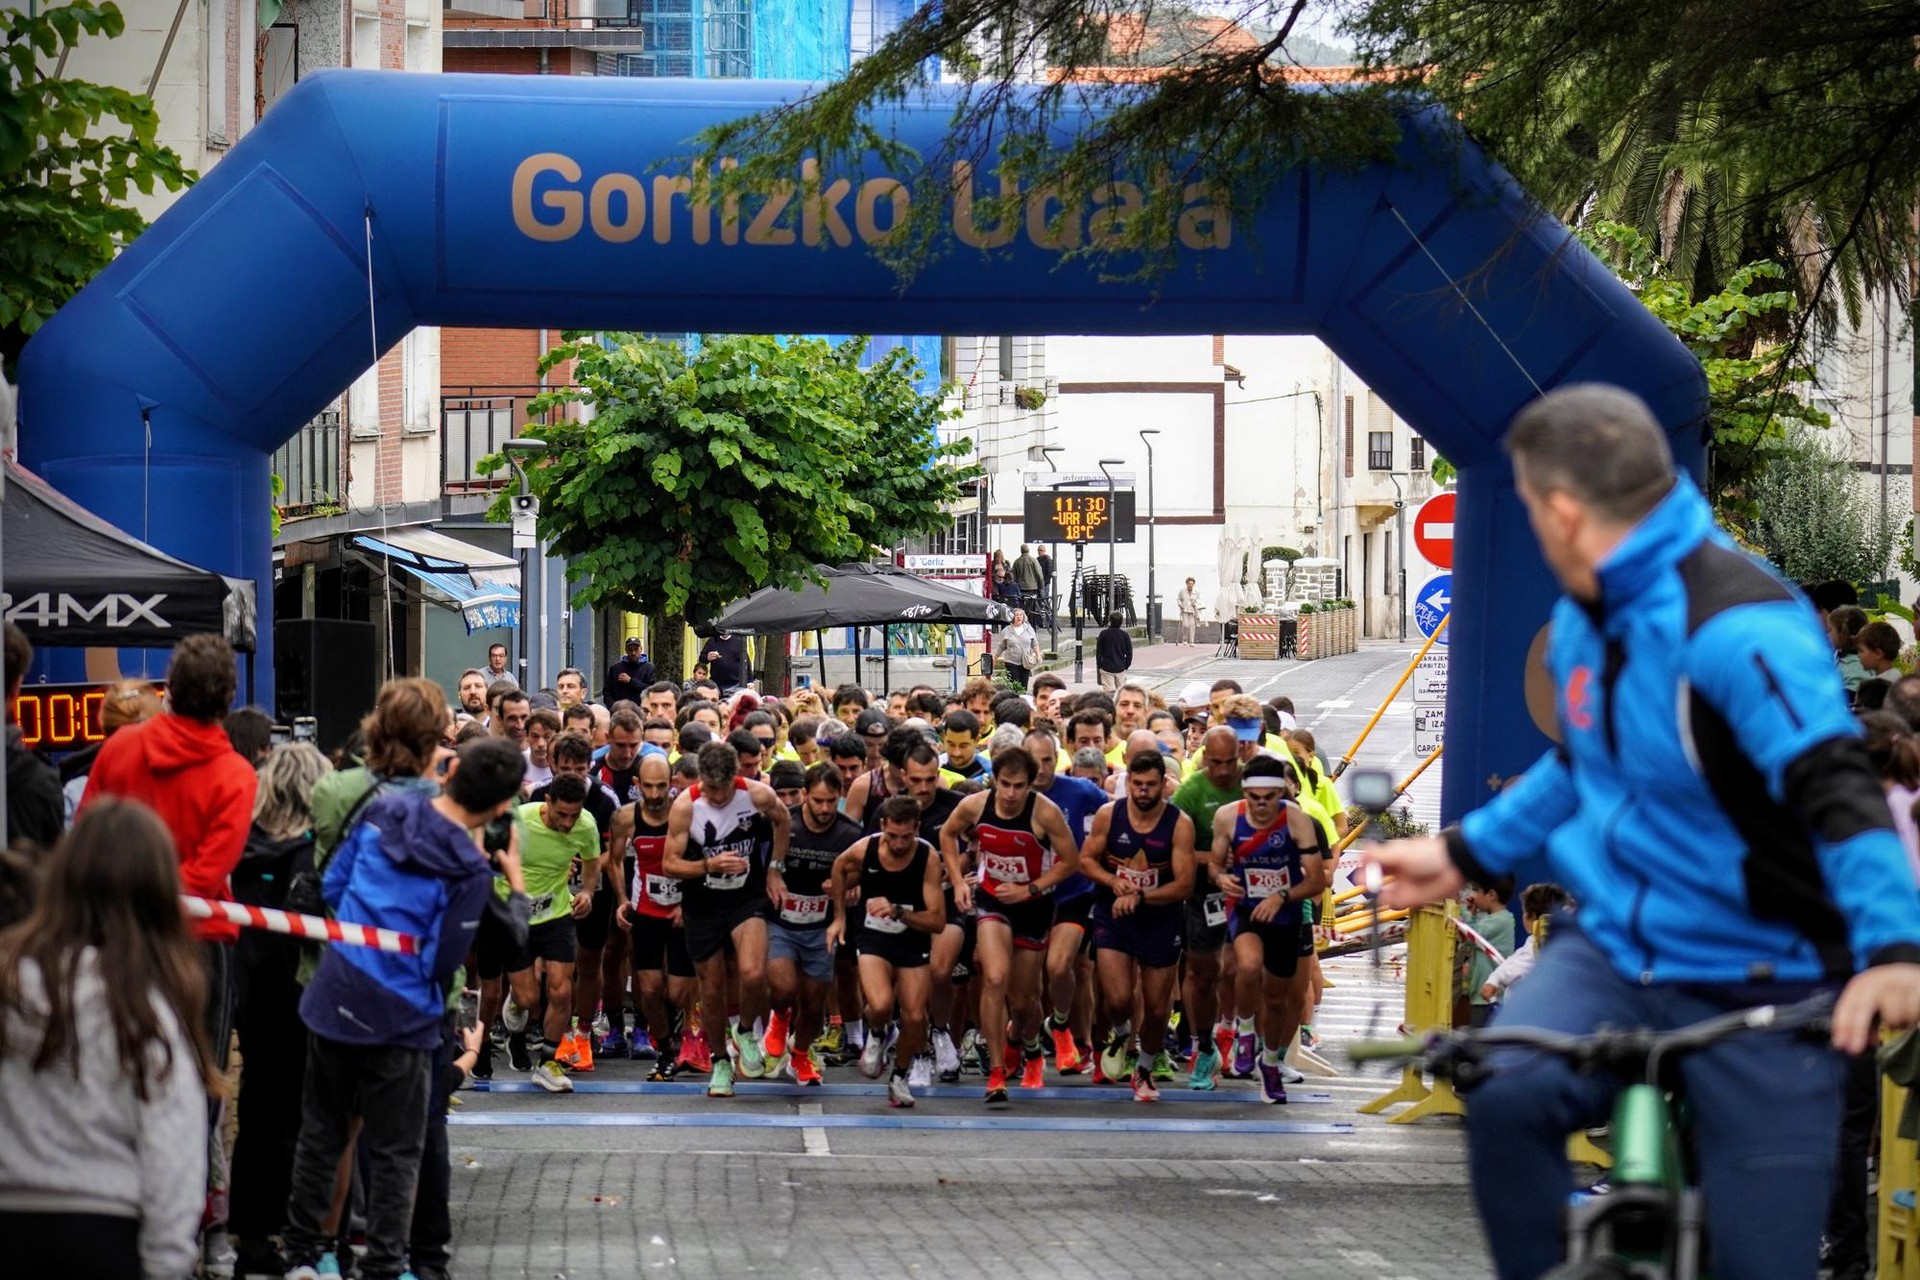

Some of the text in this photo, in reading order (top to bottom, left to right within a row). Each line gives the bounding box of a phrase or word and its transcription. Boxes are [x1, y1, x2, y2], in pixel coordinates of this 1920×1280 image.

[512, 152, 1231, 249] Gorlizko Udala
[1055, 497, 1106, 512] 11:30
[992, 861, 1018, 873] 226
[1256, 874, 1283, 887] 208
[659, 882, 678, 894] 96
[793, 901, 820, 913] 183
